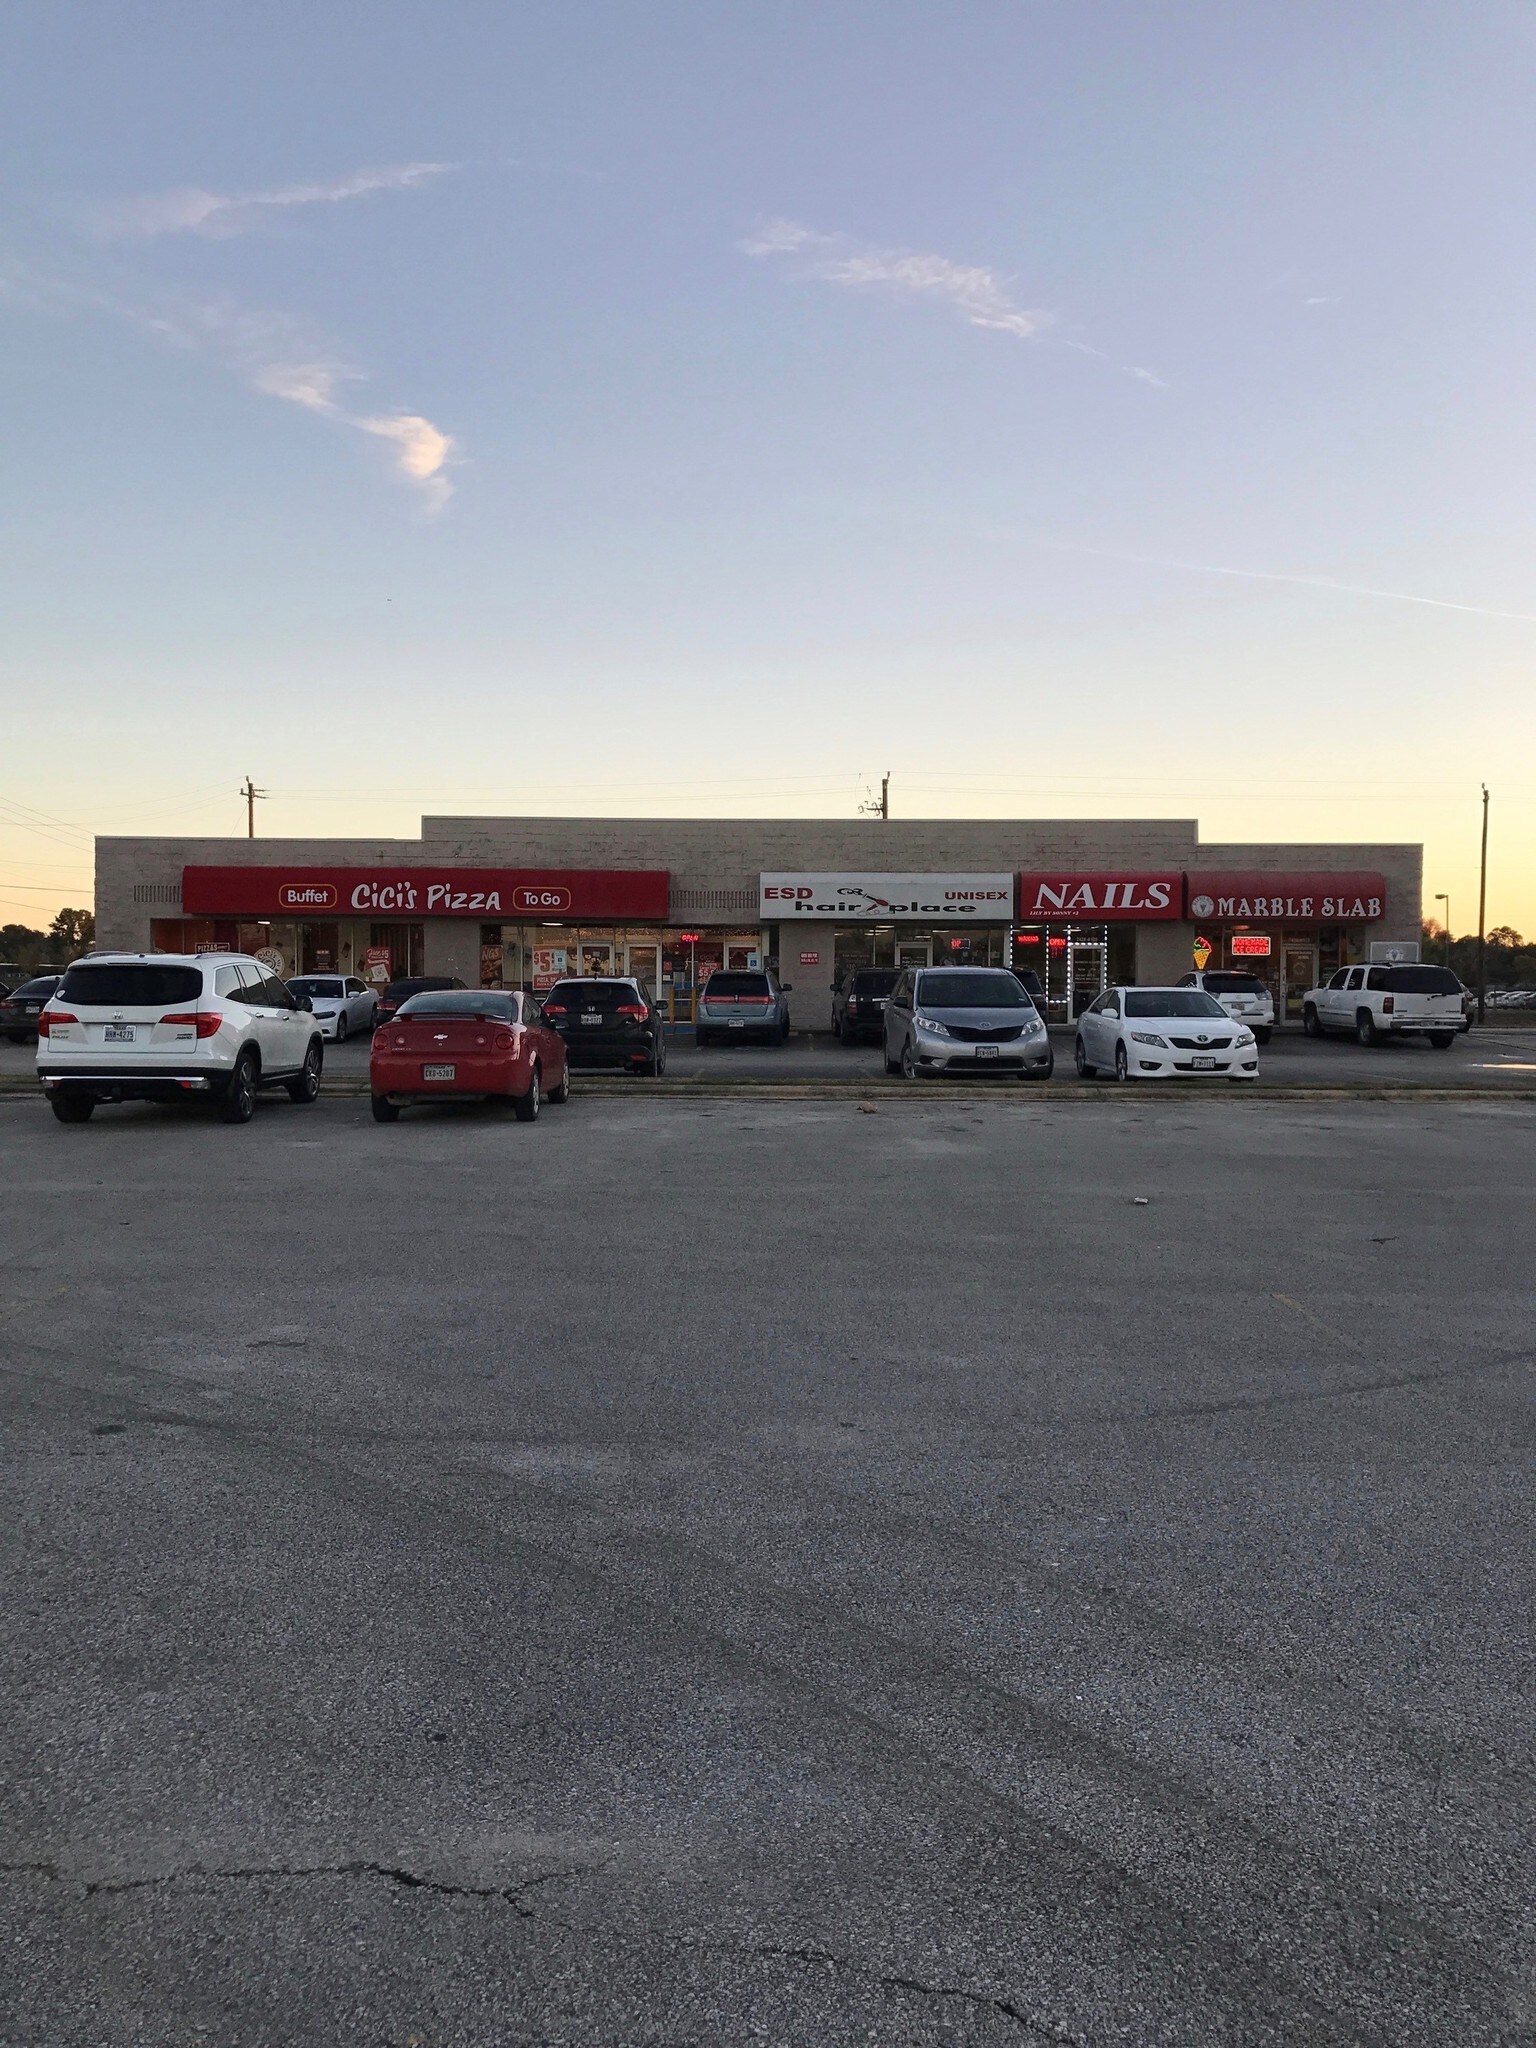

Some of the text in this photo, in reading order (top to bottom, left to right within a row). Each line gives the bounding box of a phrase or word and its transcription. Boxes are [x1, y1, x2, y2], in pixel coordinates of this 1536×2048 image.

[287, 889, 329, 903] Buffet
[523, 891, 561, 906] To Go
[764, 887, 814, 900] ESD
[944, 891, 1009, 900] UNISEX
[1032, 882, 1172, 910] NAILS
[795, 901, 977, 915] hair place
[1217, 897, 1314, 918] MARBLE
[1321, 897, 1382, 918] SLAB
[681, 934, 699, 942] OPEN
[1049, 938, 1066, 946] OPEN
[1233, 938, 1269, 946] HOMEMADE
[1233, 946, 1269, 954] ICE CREAM
